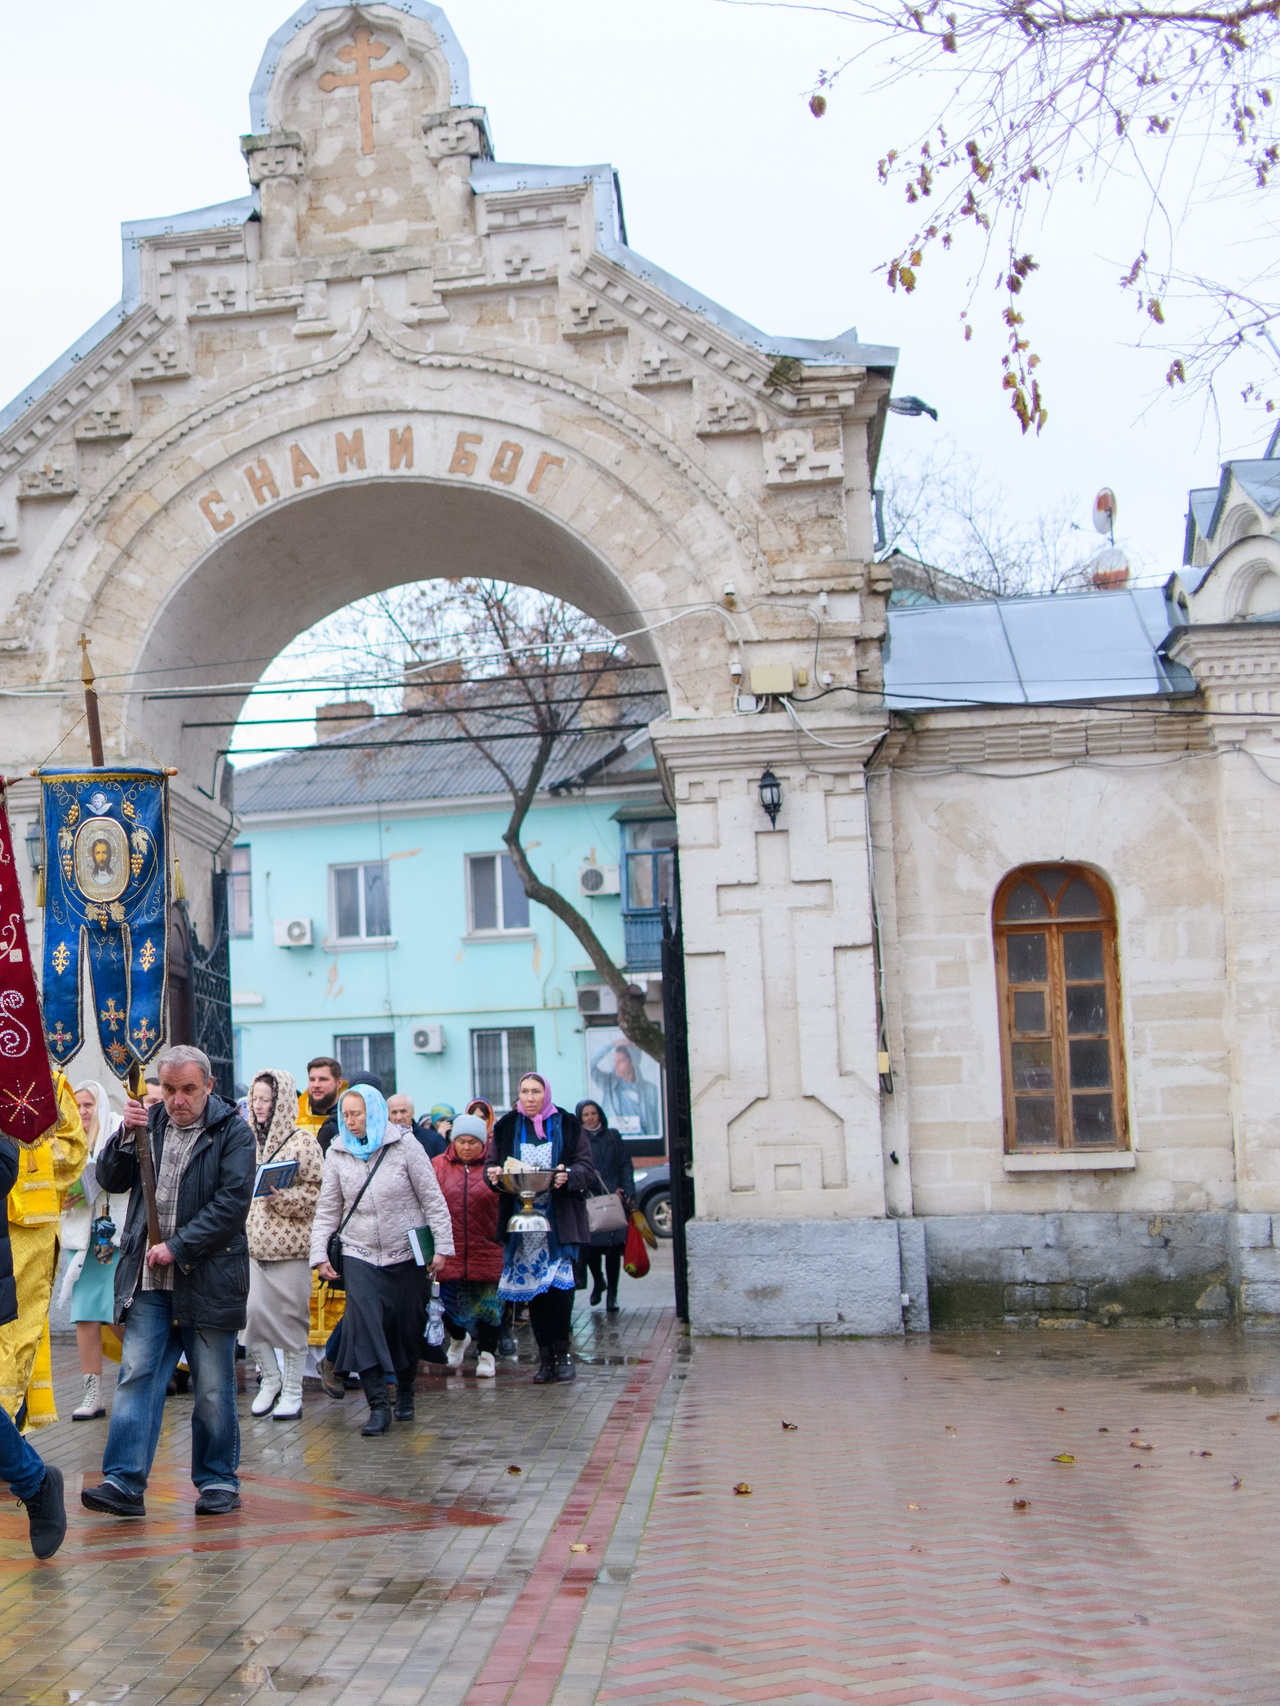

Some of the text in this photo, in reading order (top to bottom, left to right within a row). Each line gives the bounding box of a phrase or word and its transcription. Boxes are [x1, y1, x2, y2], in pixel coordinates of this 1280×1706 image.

[199, 425, 564, 533] С НАМИ БОГ
